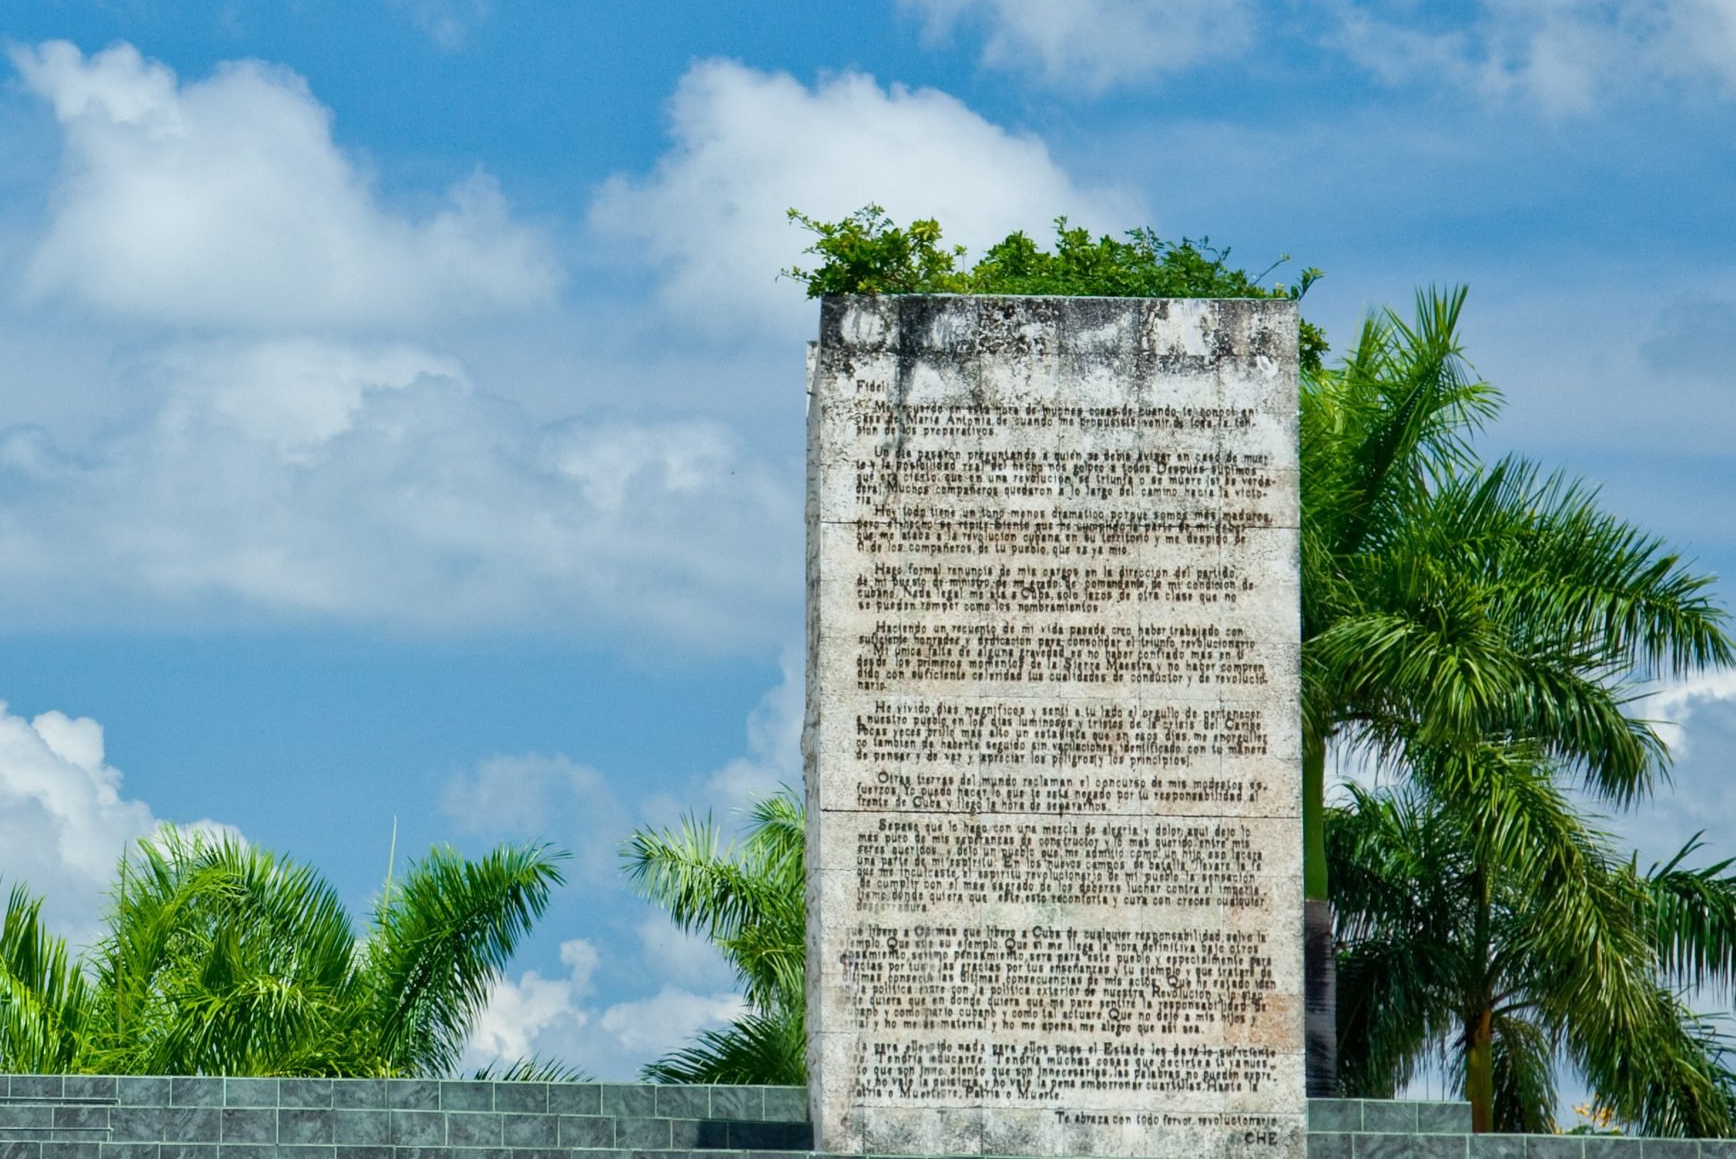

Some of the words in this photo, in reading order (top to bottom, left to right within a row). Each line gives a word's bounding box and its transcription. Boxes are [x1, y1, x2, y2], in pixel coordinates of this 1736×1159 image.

[876, 622, 926, 634] Haciendo
[934, 625, 946, 633] un
[1226, 628, 1243, 636] con
[878, 771, 911, 785] Otras
[982, 776, 1016, 787] mundo
[1023, 776, 1073, 788] reclaman
[1245, 1132, 1277, 1146] CHE
